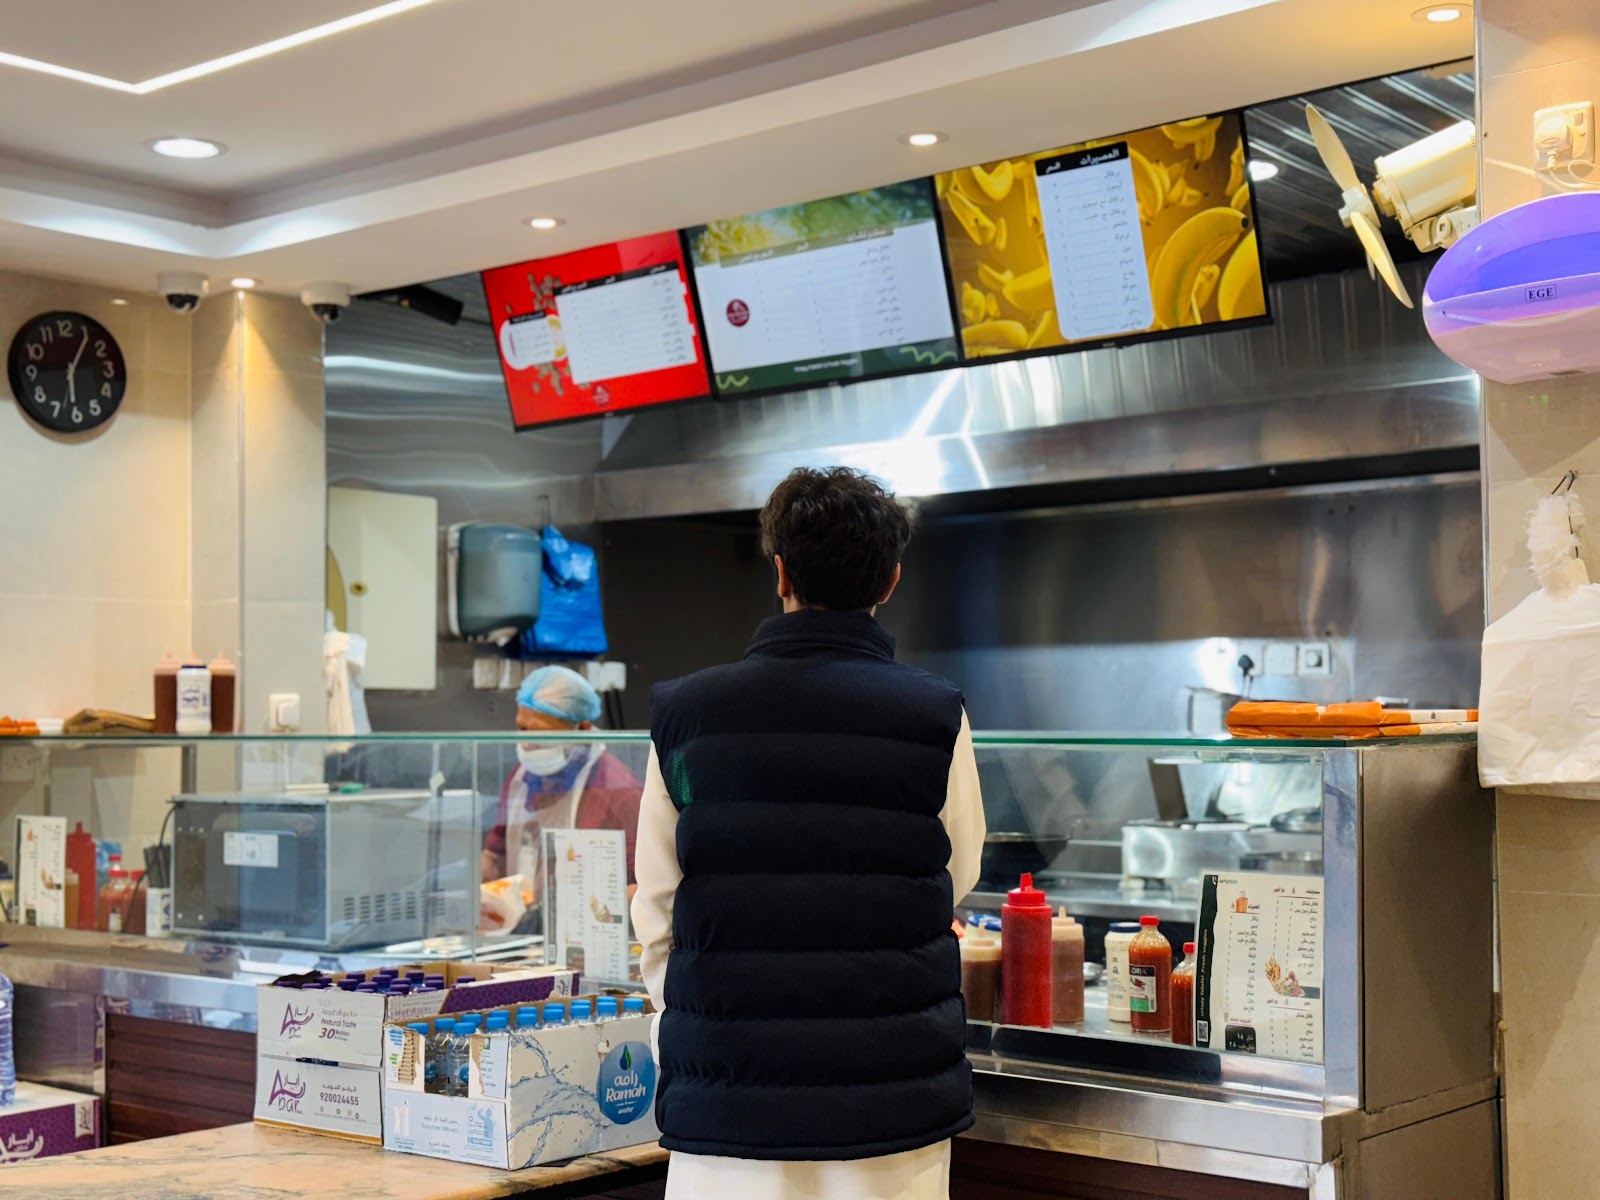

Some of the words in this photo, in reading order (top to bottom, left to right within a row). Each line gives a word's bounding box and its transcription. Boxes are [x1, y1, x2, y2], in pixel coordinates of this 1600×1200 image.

[1529, 288, 1553, 299] EGE
[40, 326, 53, 342] 11
[56, 320, 73, 337] 12
[26, 343, 44, 360] 10
[94, 340, 106, 357] 2
[26, 365, 37, 381] 9
[103, 361, 114, 378] 3
[34, 386, 46, 403] 8
[101, 382, 112, 398] 4
[50, 401, 61, 418] 7
[71, 406, 83, 423] 6
[89, 399, 101, 416] 5
[321, 1018, 341, 1027] Natural
[342, 1020, 356, 1028] Taste
[319, 1027, 335, 1039] 30
[320, 1092, 359, 1105] 920024455
[606, 1083, 646, 1102] Ramah
